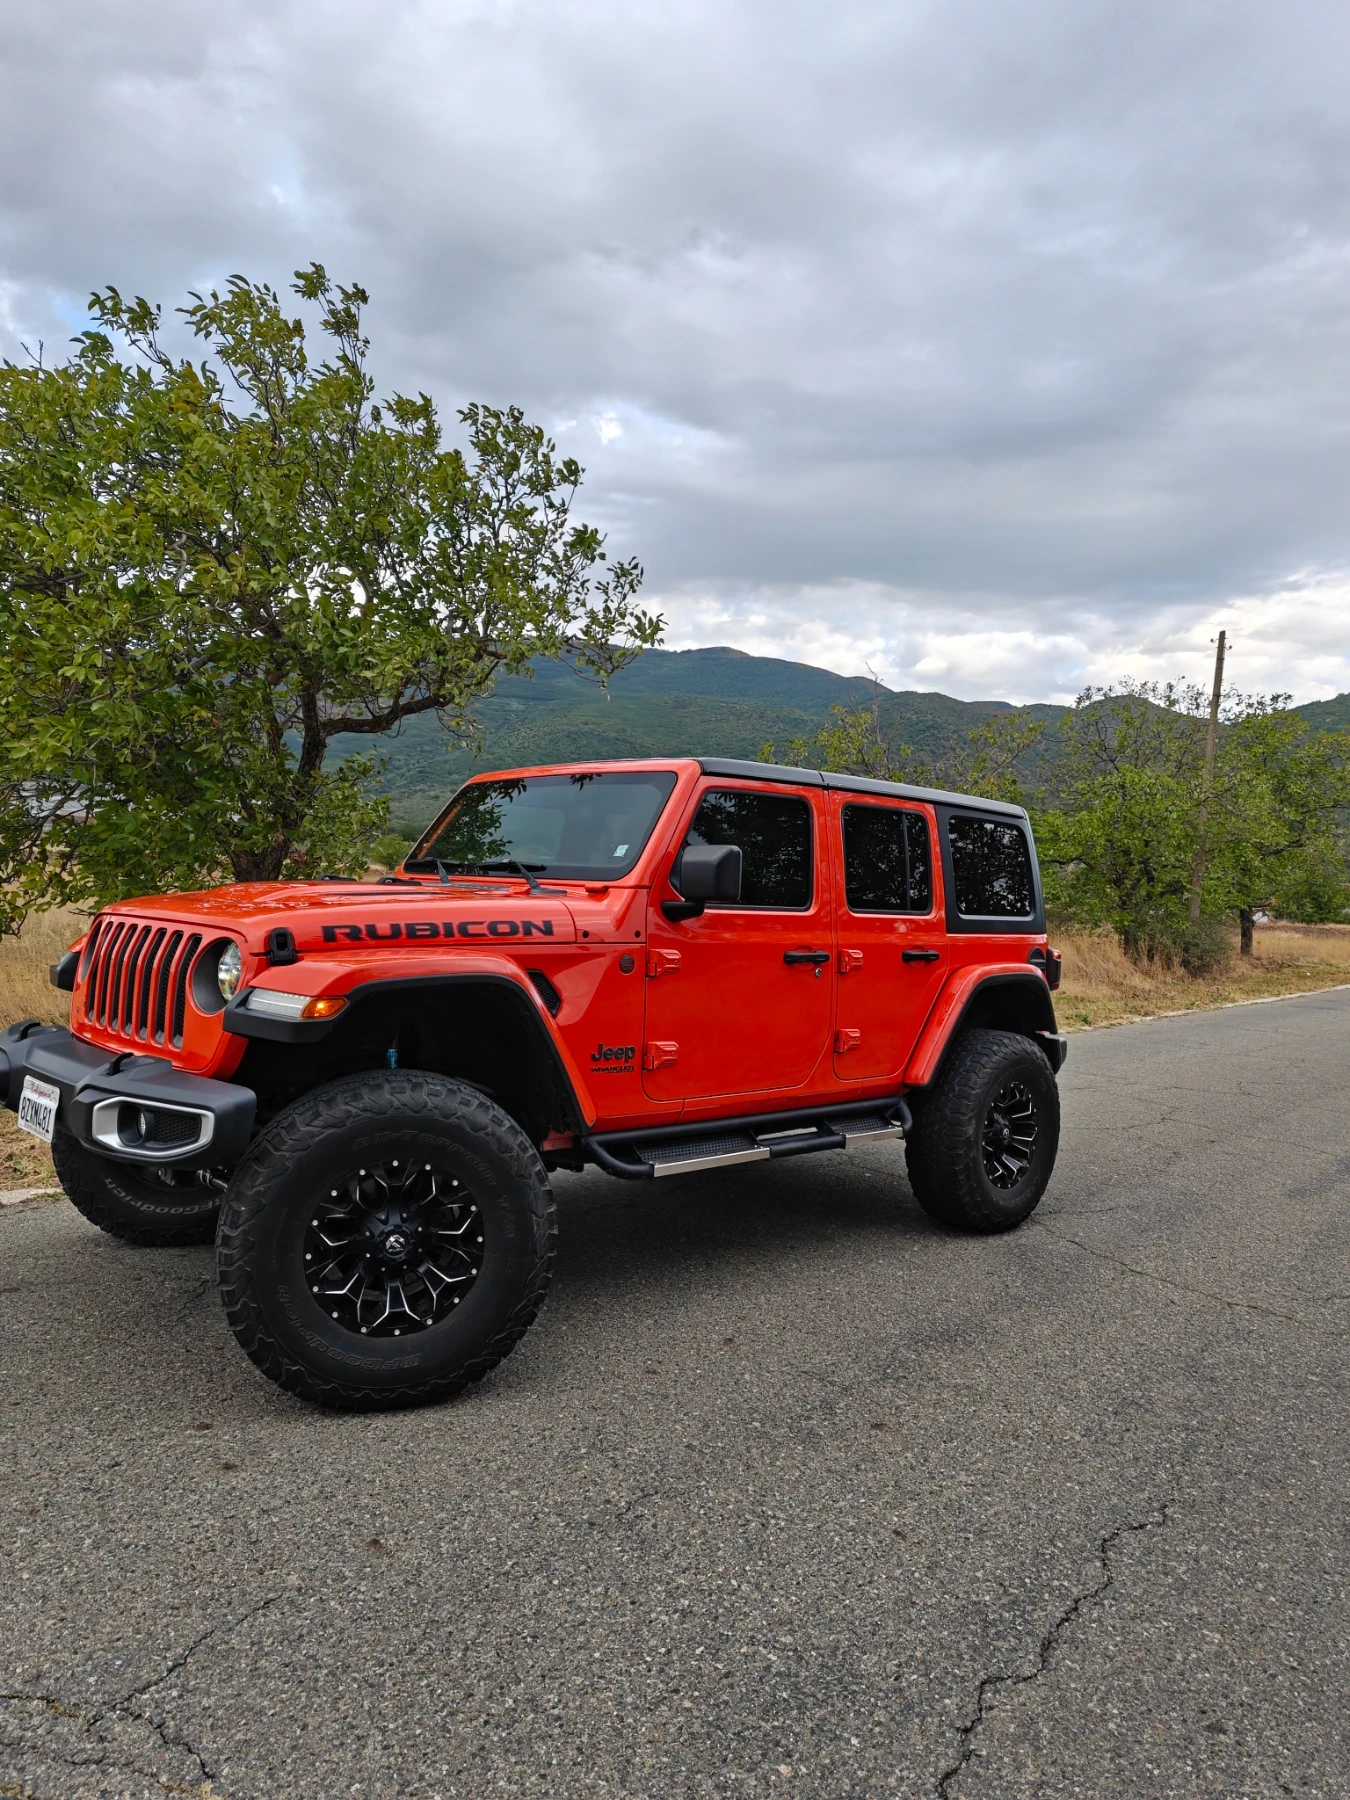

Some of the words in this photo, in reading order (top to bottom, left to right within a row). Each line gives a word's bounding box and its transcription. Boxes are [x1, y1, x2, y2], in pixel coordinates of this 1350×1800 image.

[321, 920, 554, 943] RUBICON
[591, 1043, 636, 1064] Jeep
[590, 1065, 635, 1073] WRANGLER
[277, 1285, 422, 1371] BFGoodrich
